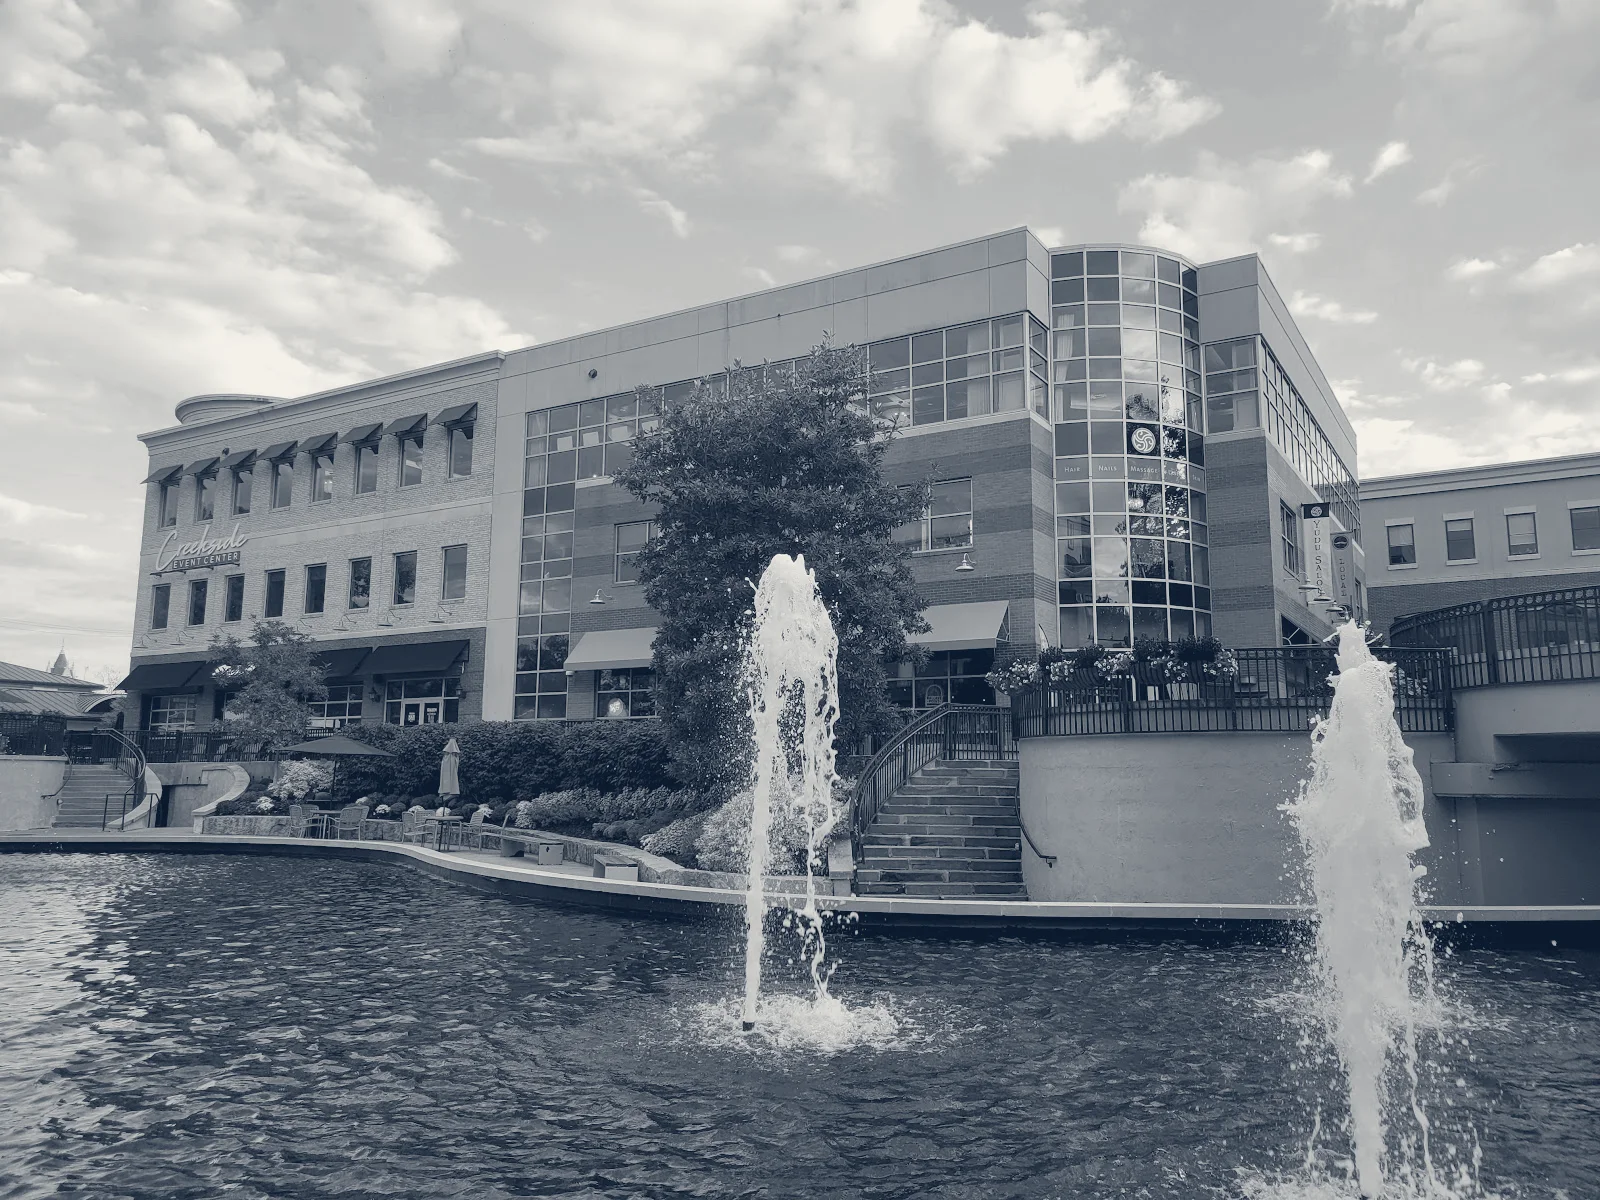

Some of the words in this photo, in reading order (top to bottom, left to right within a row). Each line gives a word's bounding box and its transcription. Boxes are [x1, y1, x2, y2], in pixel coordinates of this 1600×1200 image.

[156, 523, 248, 571] Creekside
[1313, 519, 1321, 551] YUDU
[172, 557, 202, 569] EVENT
[203, 552, 238, 564] CENTER
[1339, 558, 1347, 597] LOCAL
